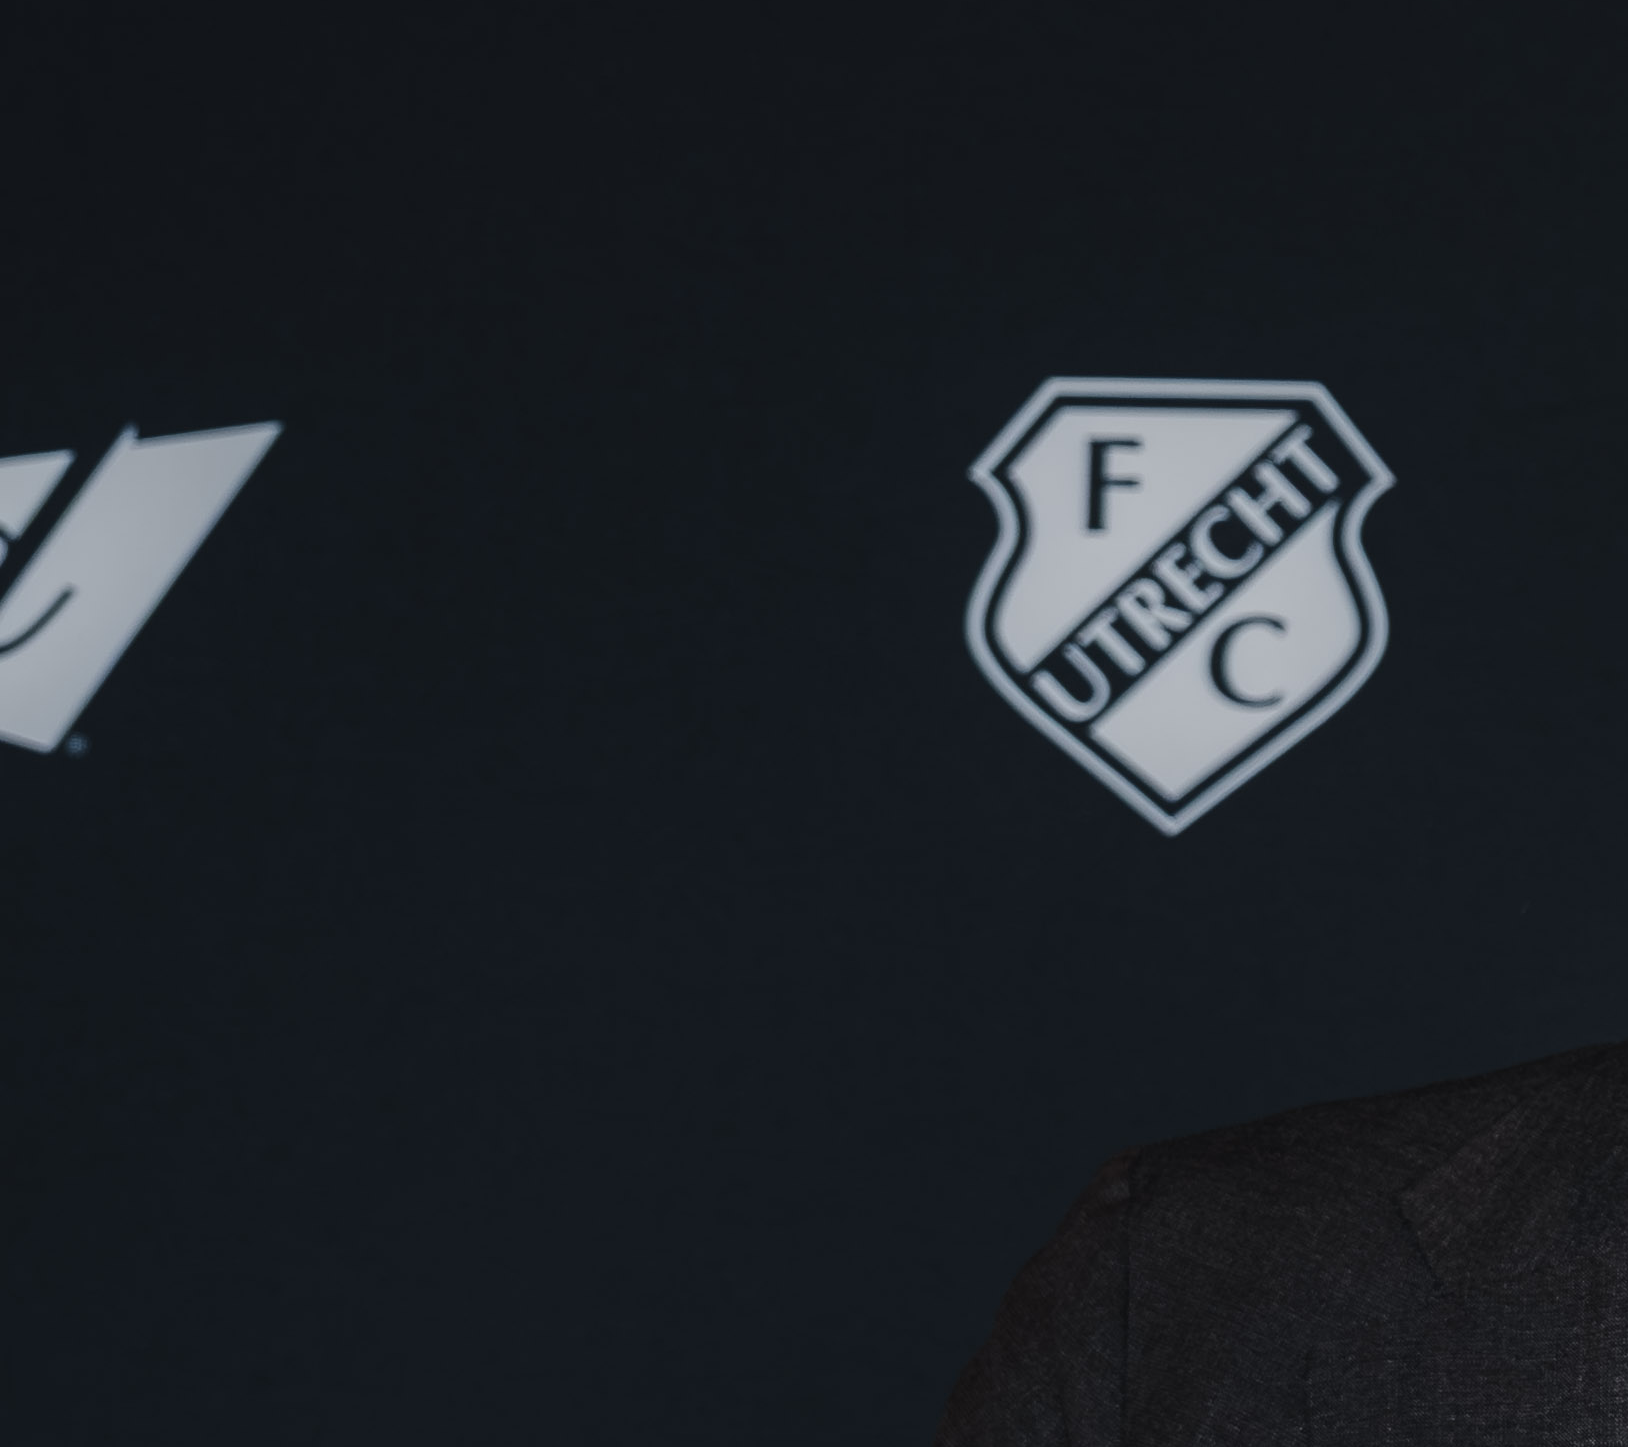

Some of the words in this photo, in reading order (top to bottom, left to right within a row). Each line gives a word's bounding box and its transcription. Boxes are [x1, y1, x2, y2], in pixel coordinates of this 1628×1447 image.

[1085, 436, 1143, 534] F
[1030, 423, 1341, 723] UTRECHT
[1208, 612, 1288, 709] C
